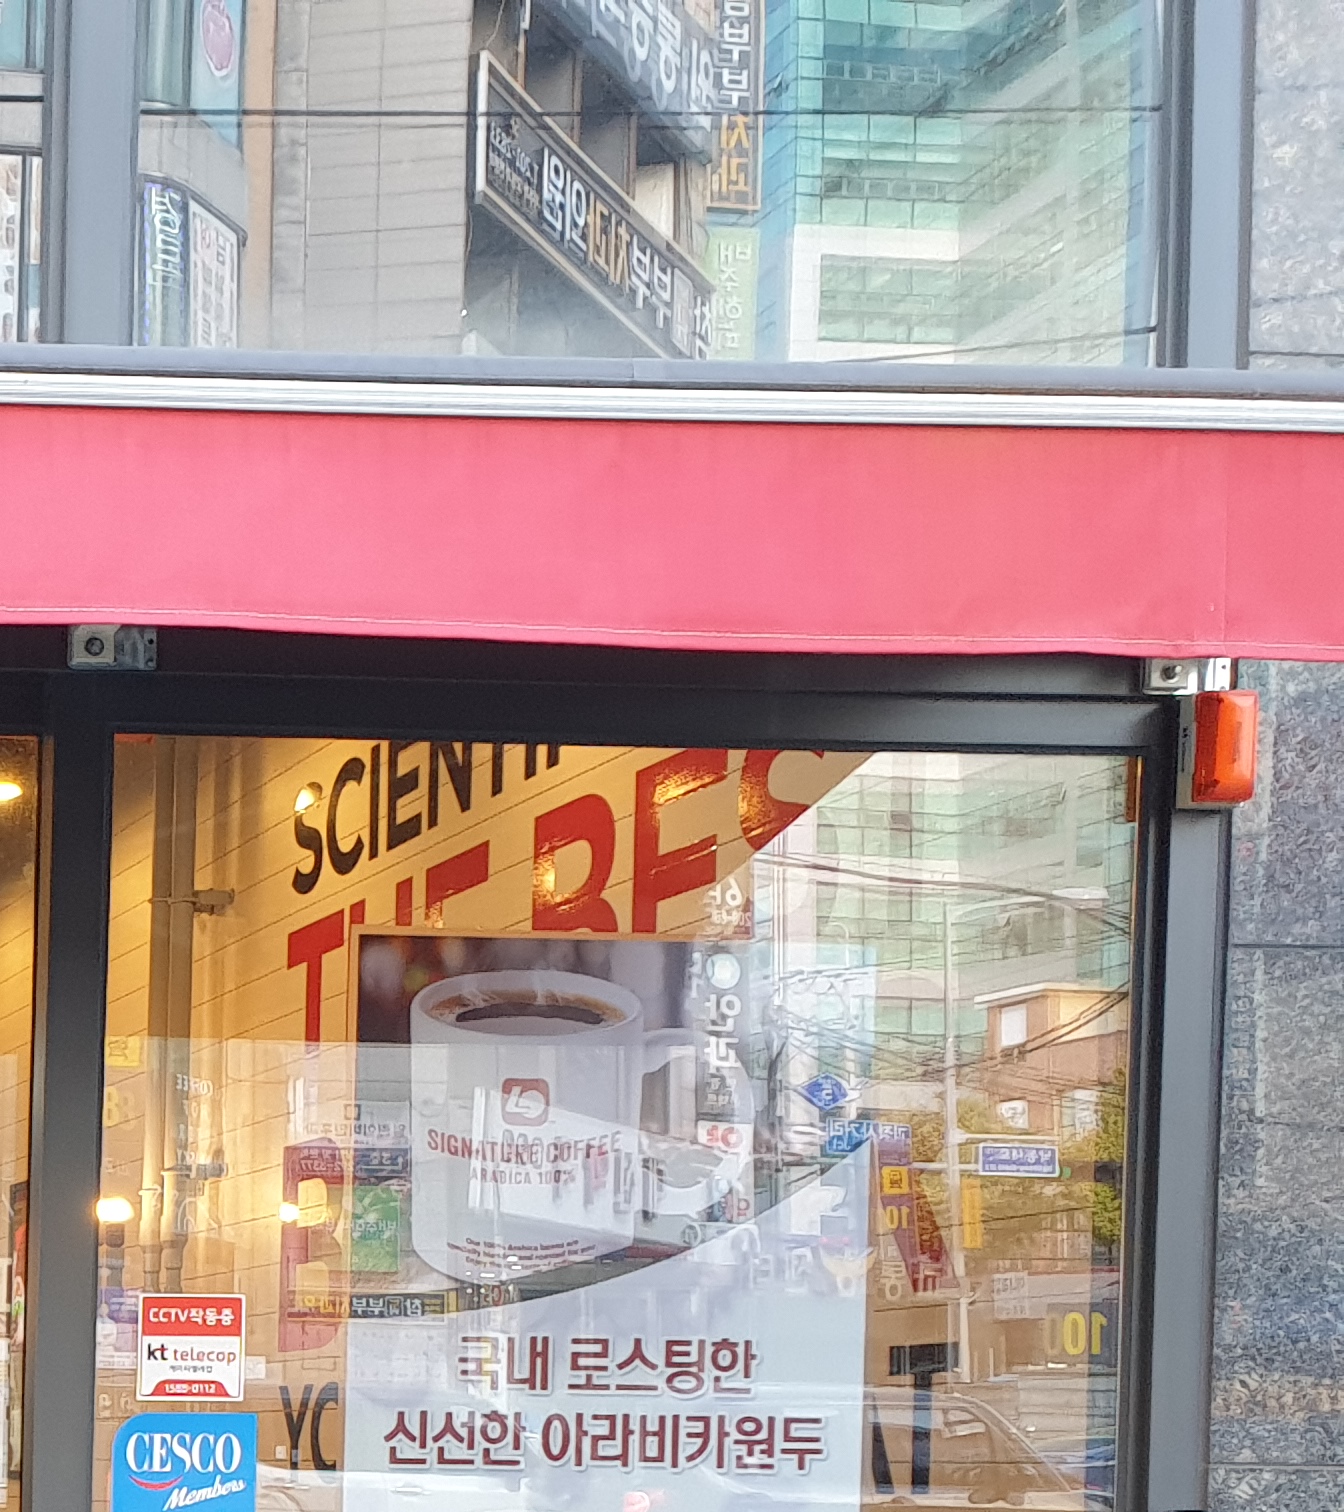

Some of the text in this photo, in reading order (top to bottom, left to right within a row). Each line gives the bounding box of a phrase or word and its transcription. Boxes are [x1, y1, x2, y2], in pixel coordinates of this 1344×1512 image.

[149, 1307, 235, 1327] CCTV작동중
[147, 1343, 237, 1364] kt telecop
[458, 1335, 757, 1395] 국내 로스팅한
[126, 1433, 241, 1473] CESCO
[383, 1411, 824, 1472] 신선한 아라비카원두
[162, 1475, 246, 1512] Members
